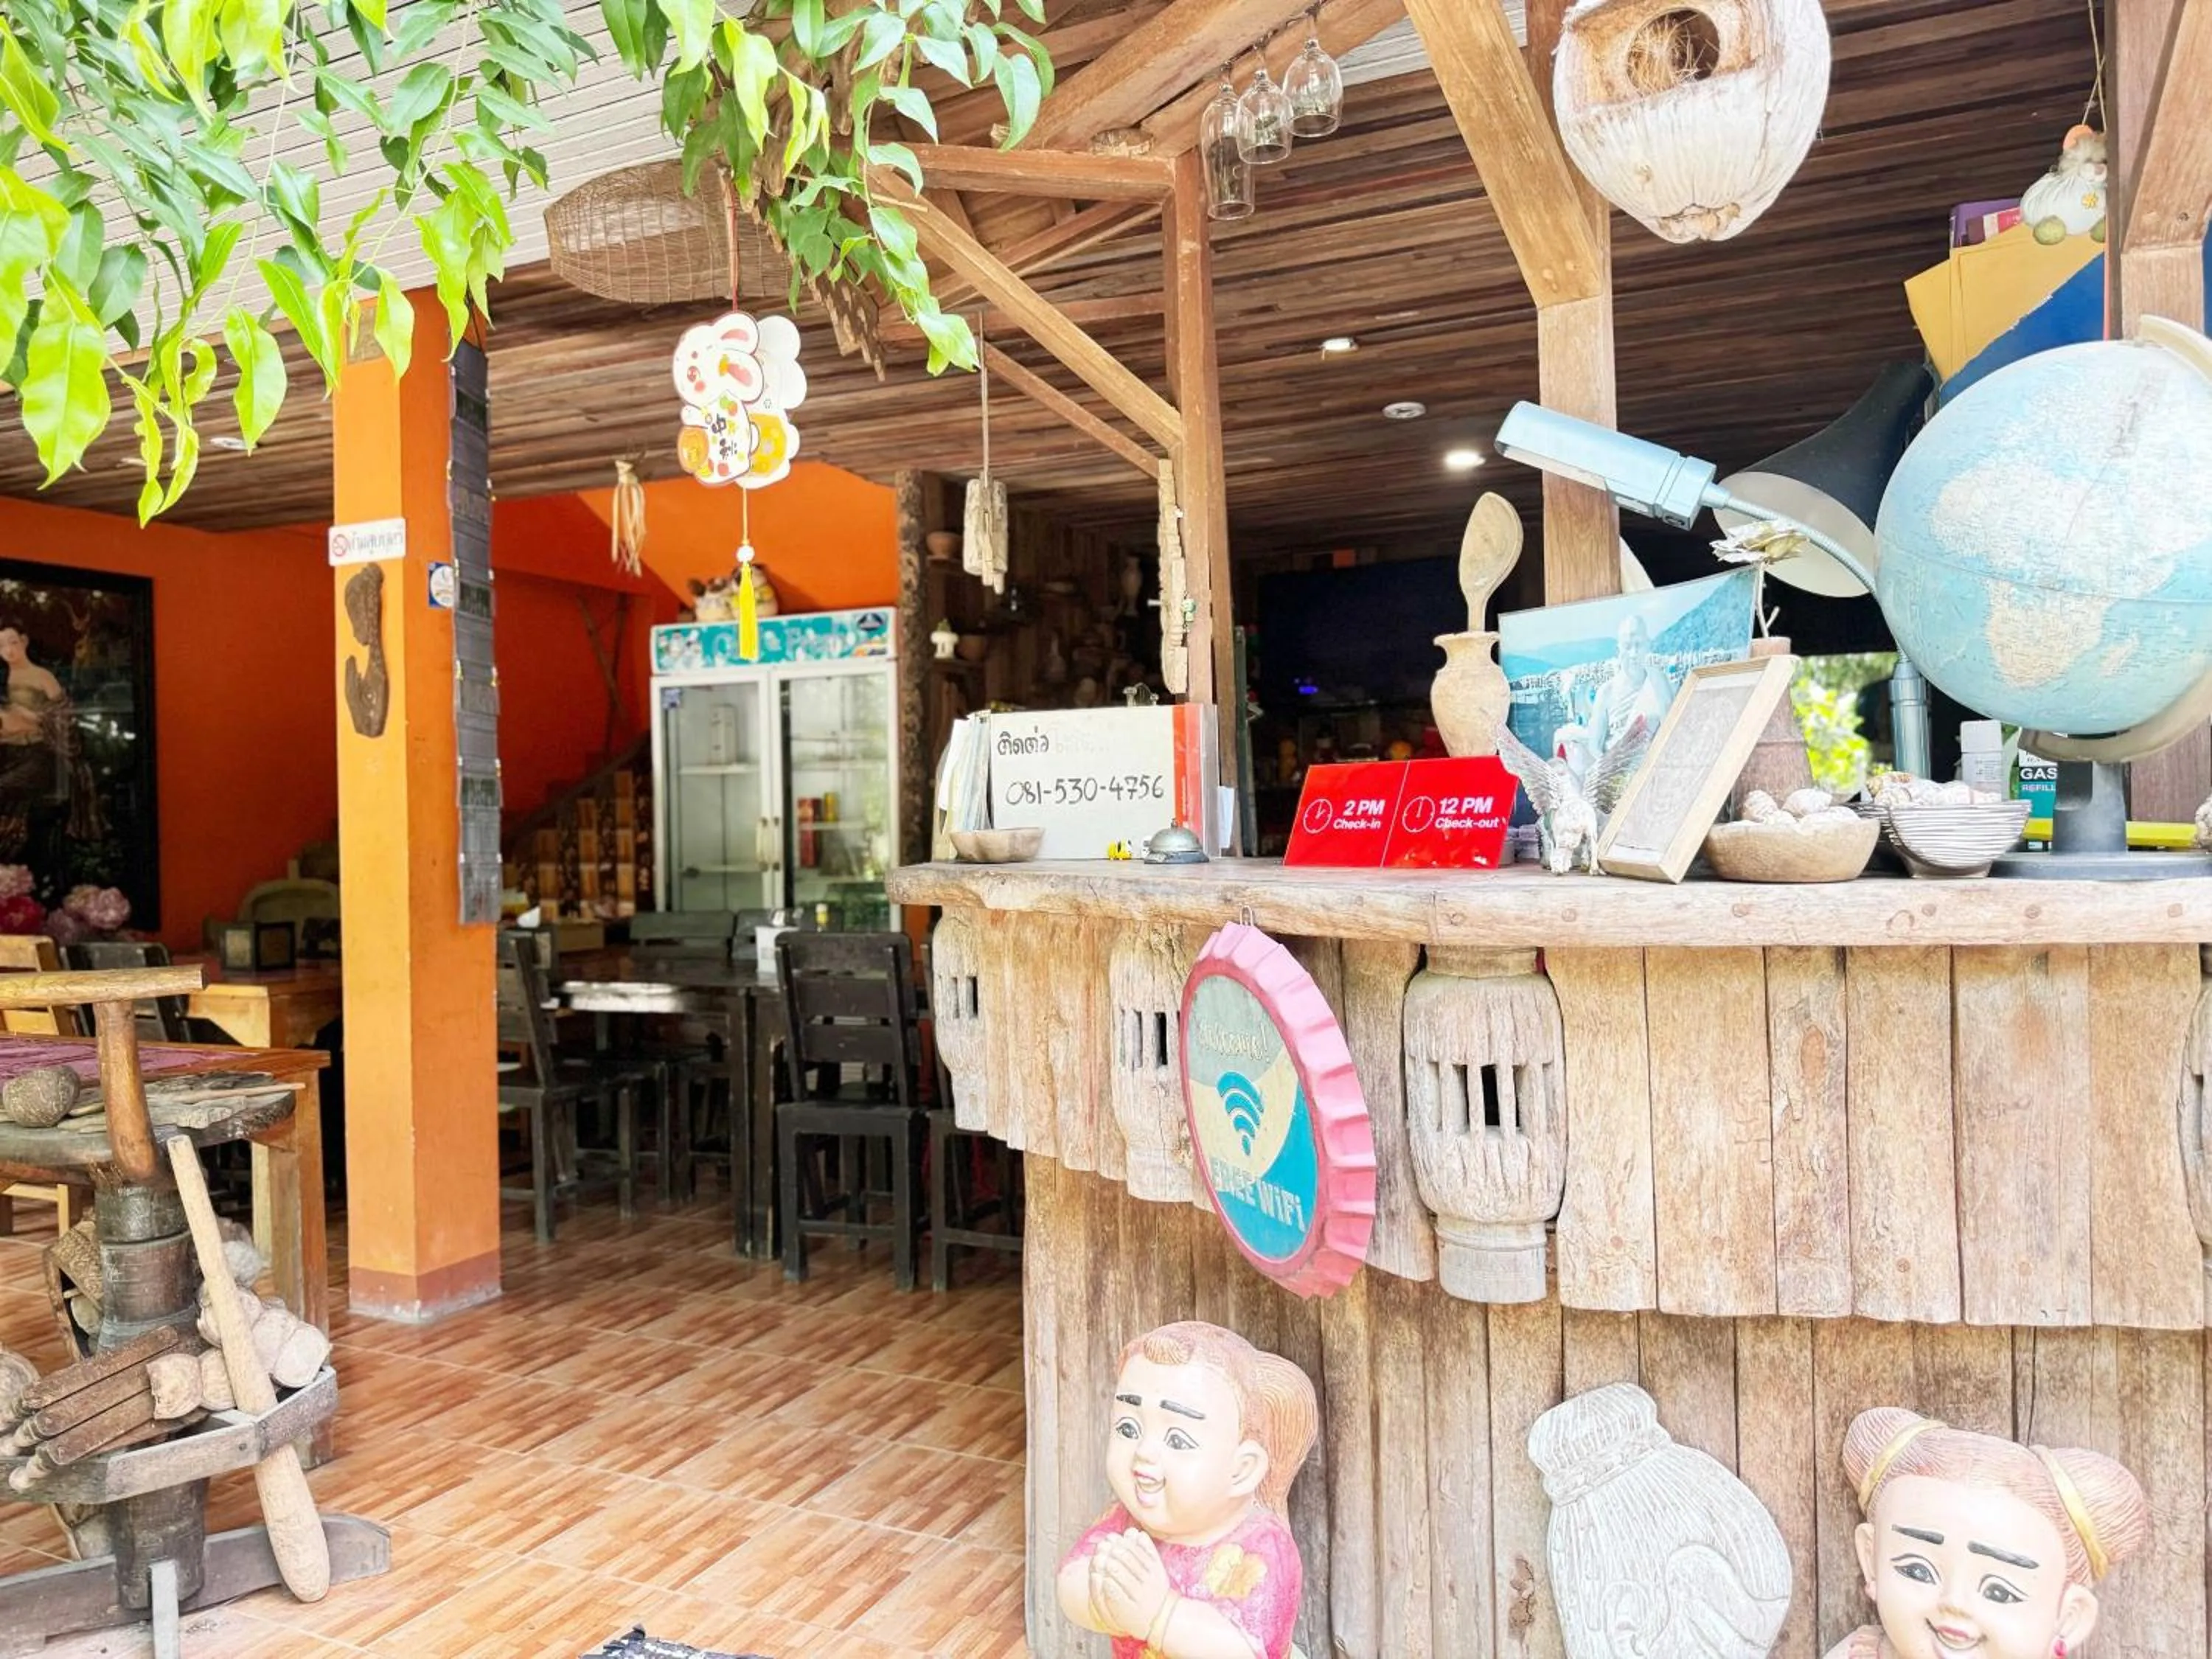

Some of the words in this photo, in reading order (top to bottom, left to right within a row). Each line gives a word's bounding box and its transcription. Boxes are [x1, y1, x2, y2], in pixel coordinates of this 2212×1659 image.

[997, 725, 1049, 755] ติดต่อ
[2020, 768, 2058, 779] GAS
[1005, 775, 1165, 805] 081-530-4756
[1343, 800, 1354, 815] 2
[1357, 799, 1385, 815] PM
[1439, 798, 1459, 814] 12
[1461, 797, 1493, 814] PM
[1333, 816, 1382, 830] Check-in
[1435, 816, 1499, 829] Check-out
